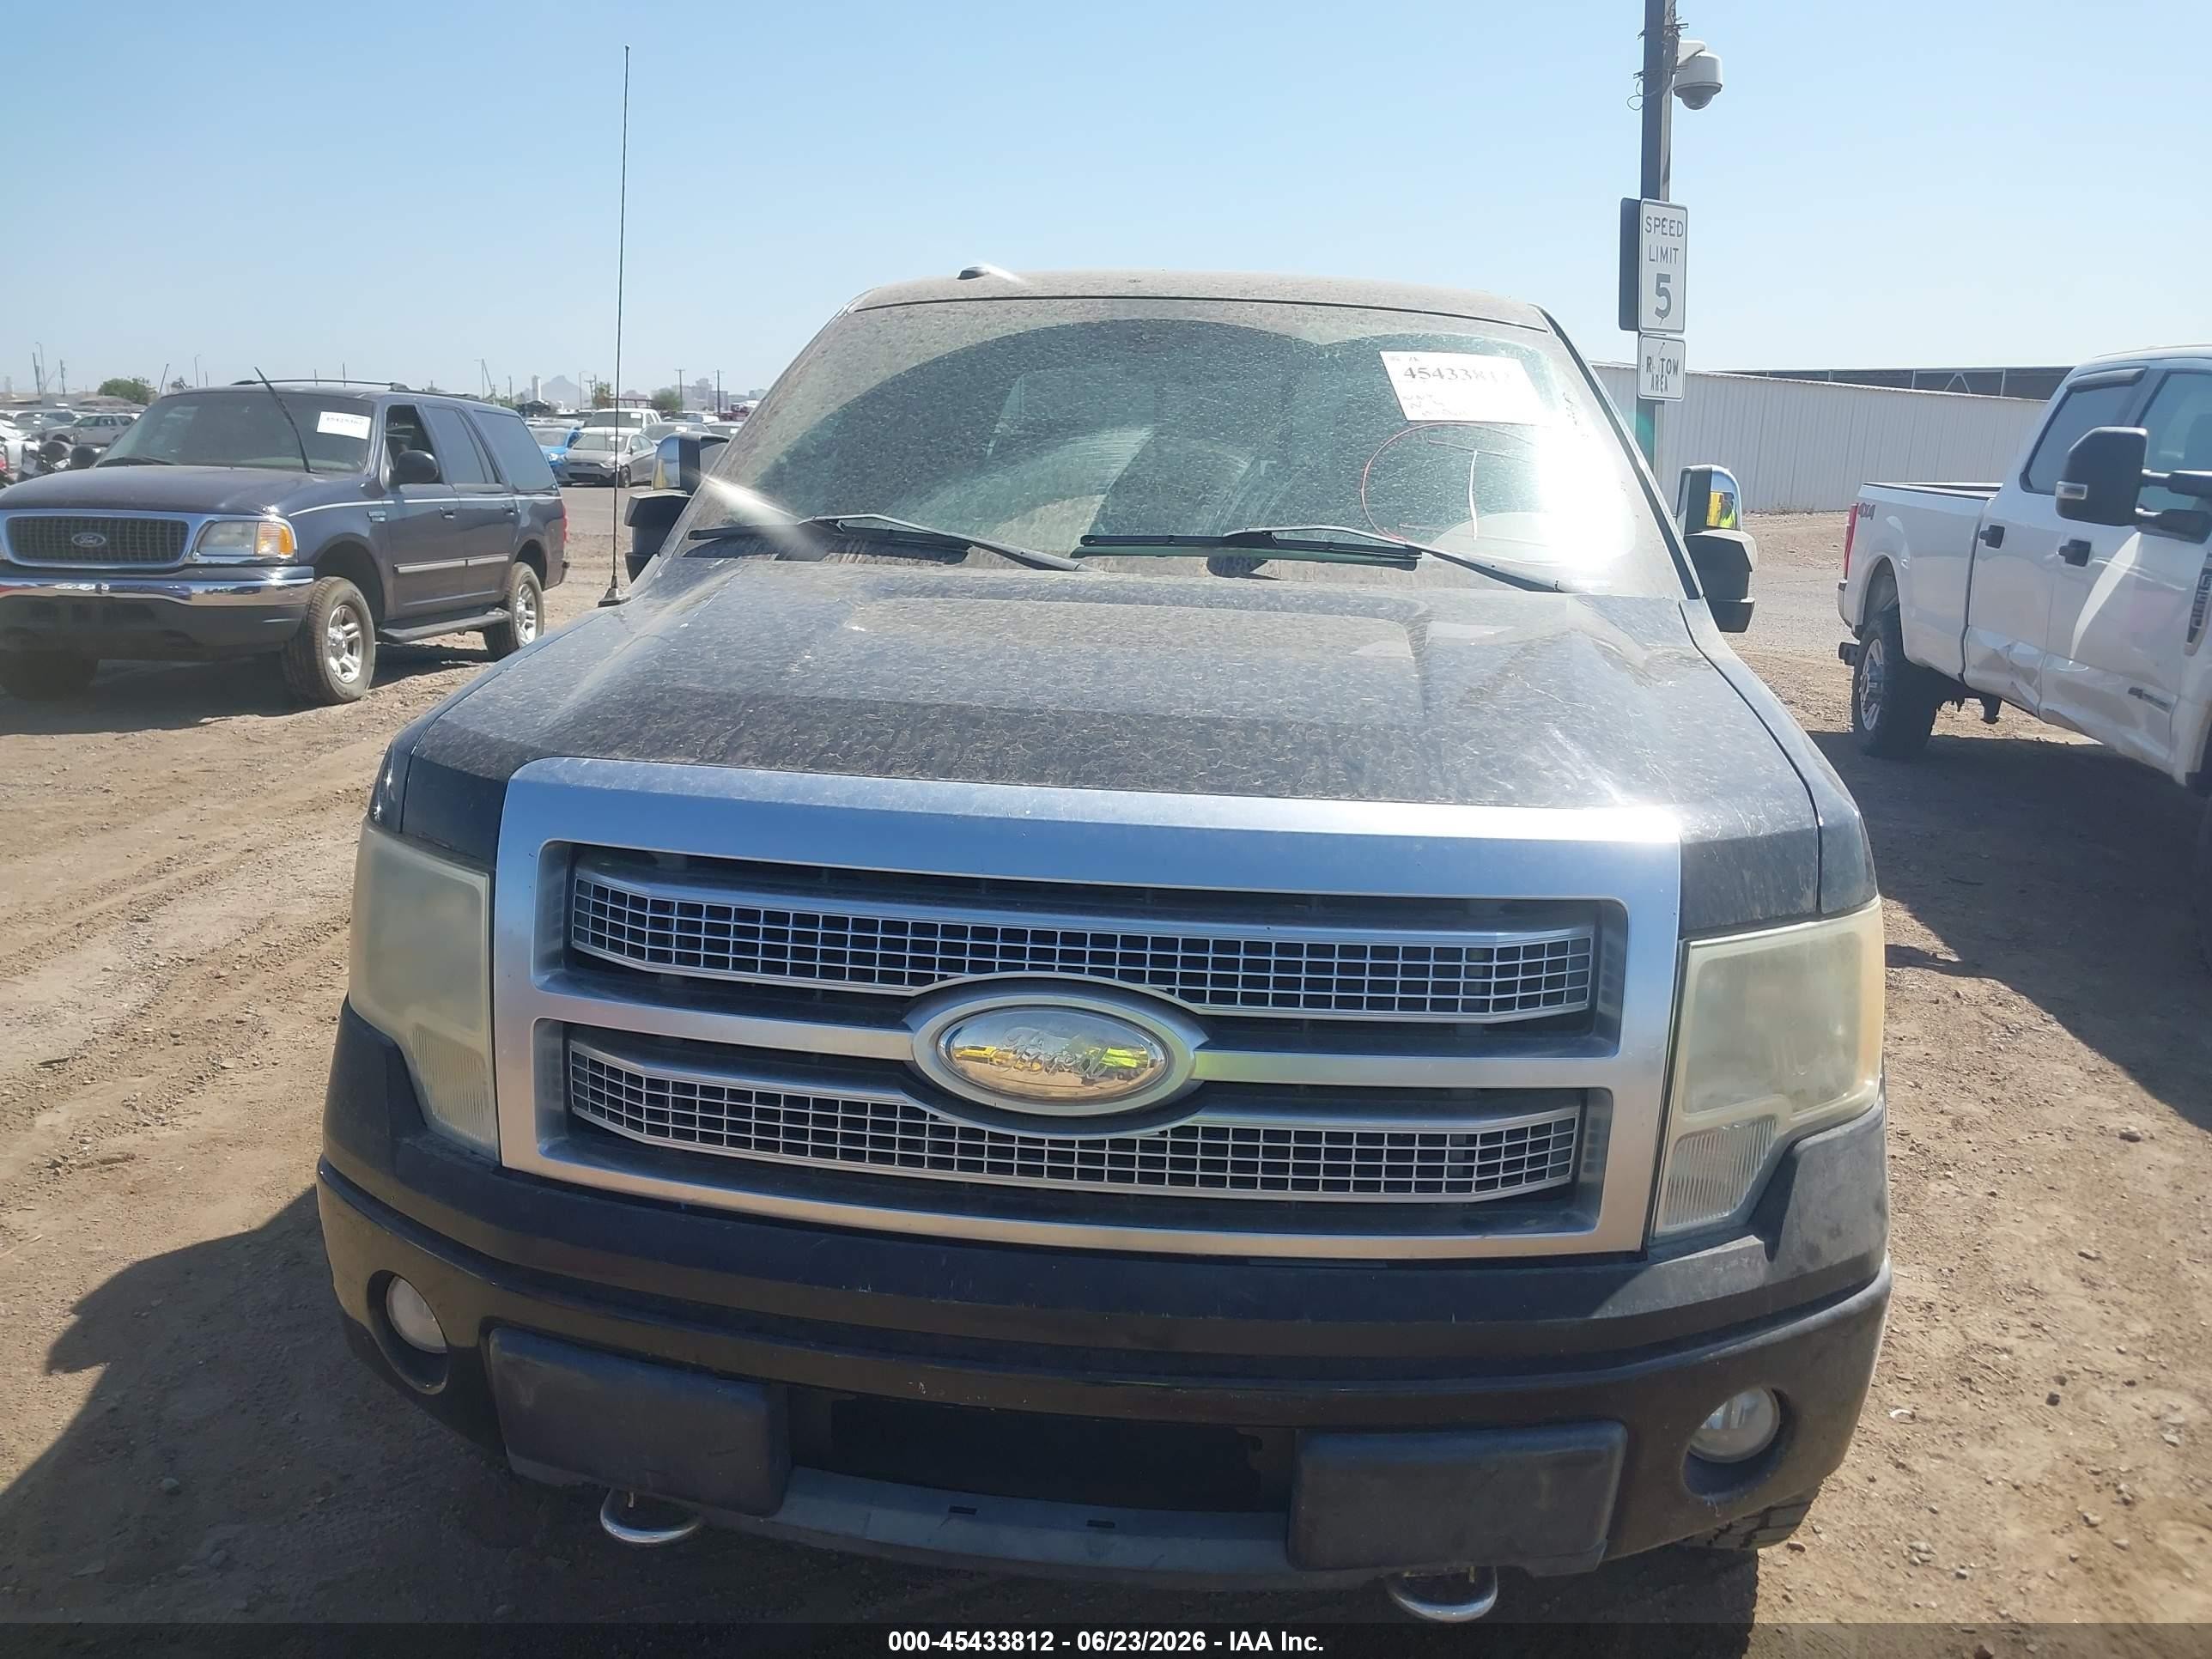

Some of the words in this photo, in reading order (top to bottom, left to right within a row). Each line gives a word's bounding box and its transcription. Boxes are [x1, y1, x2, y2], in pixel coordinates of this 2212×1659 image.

[1644, 216, 1684, 238] SPEED
[1649, 245, 1680, 264] LIMIT
[1654, 273, 1673, 319] 5
[1660, 357, 1680, 376] TOW
[1650, 374, 1668, 393] AREA
[995, 1026, 1109, 1079] Ford
